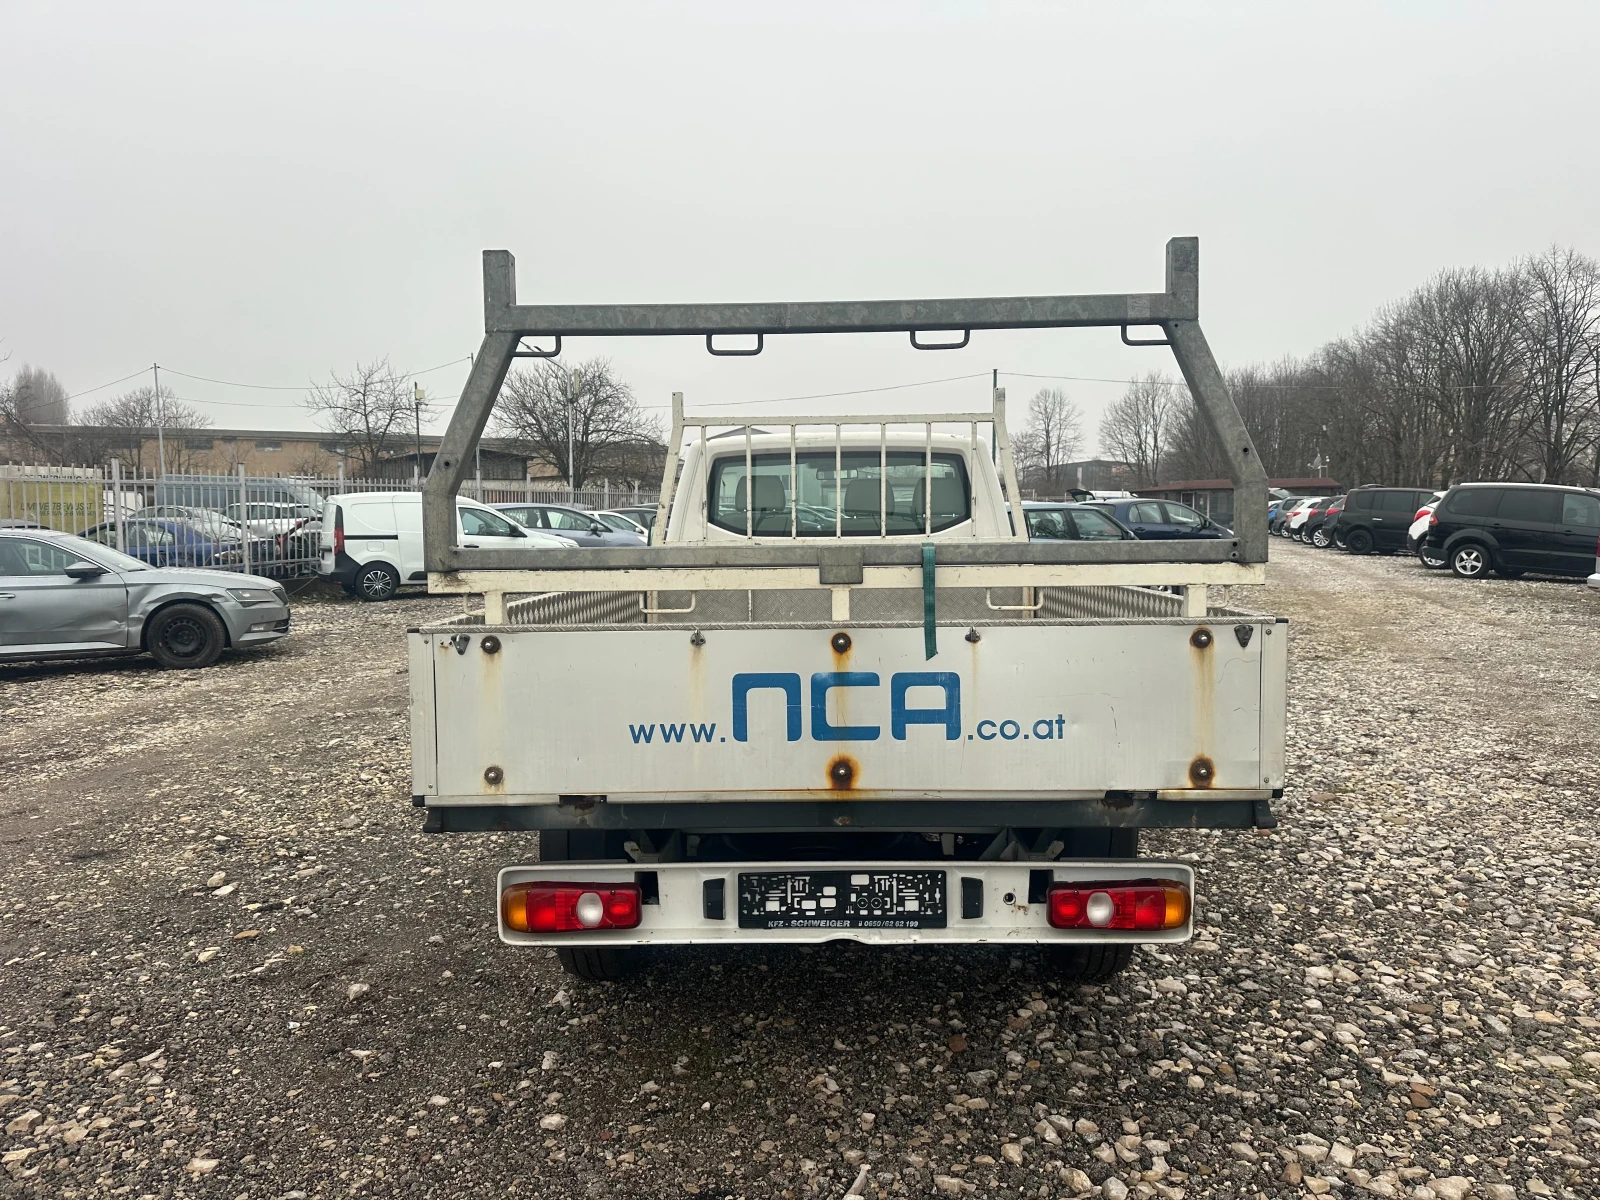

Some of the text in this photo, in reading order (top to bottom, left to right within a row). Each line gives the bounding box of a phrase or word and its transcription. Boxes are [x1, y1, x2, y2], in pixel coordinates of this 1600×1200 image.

[20, 502, 93, 510] UMWETBEWUSST
[767, 920, 784, 928] KFZ
[790, 919, 851, 928] SCHWEIGER
